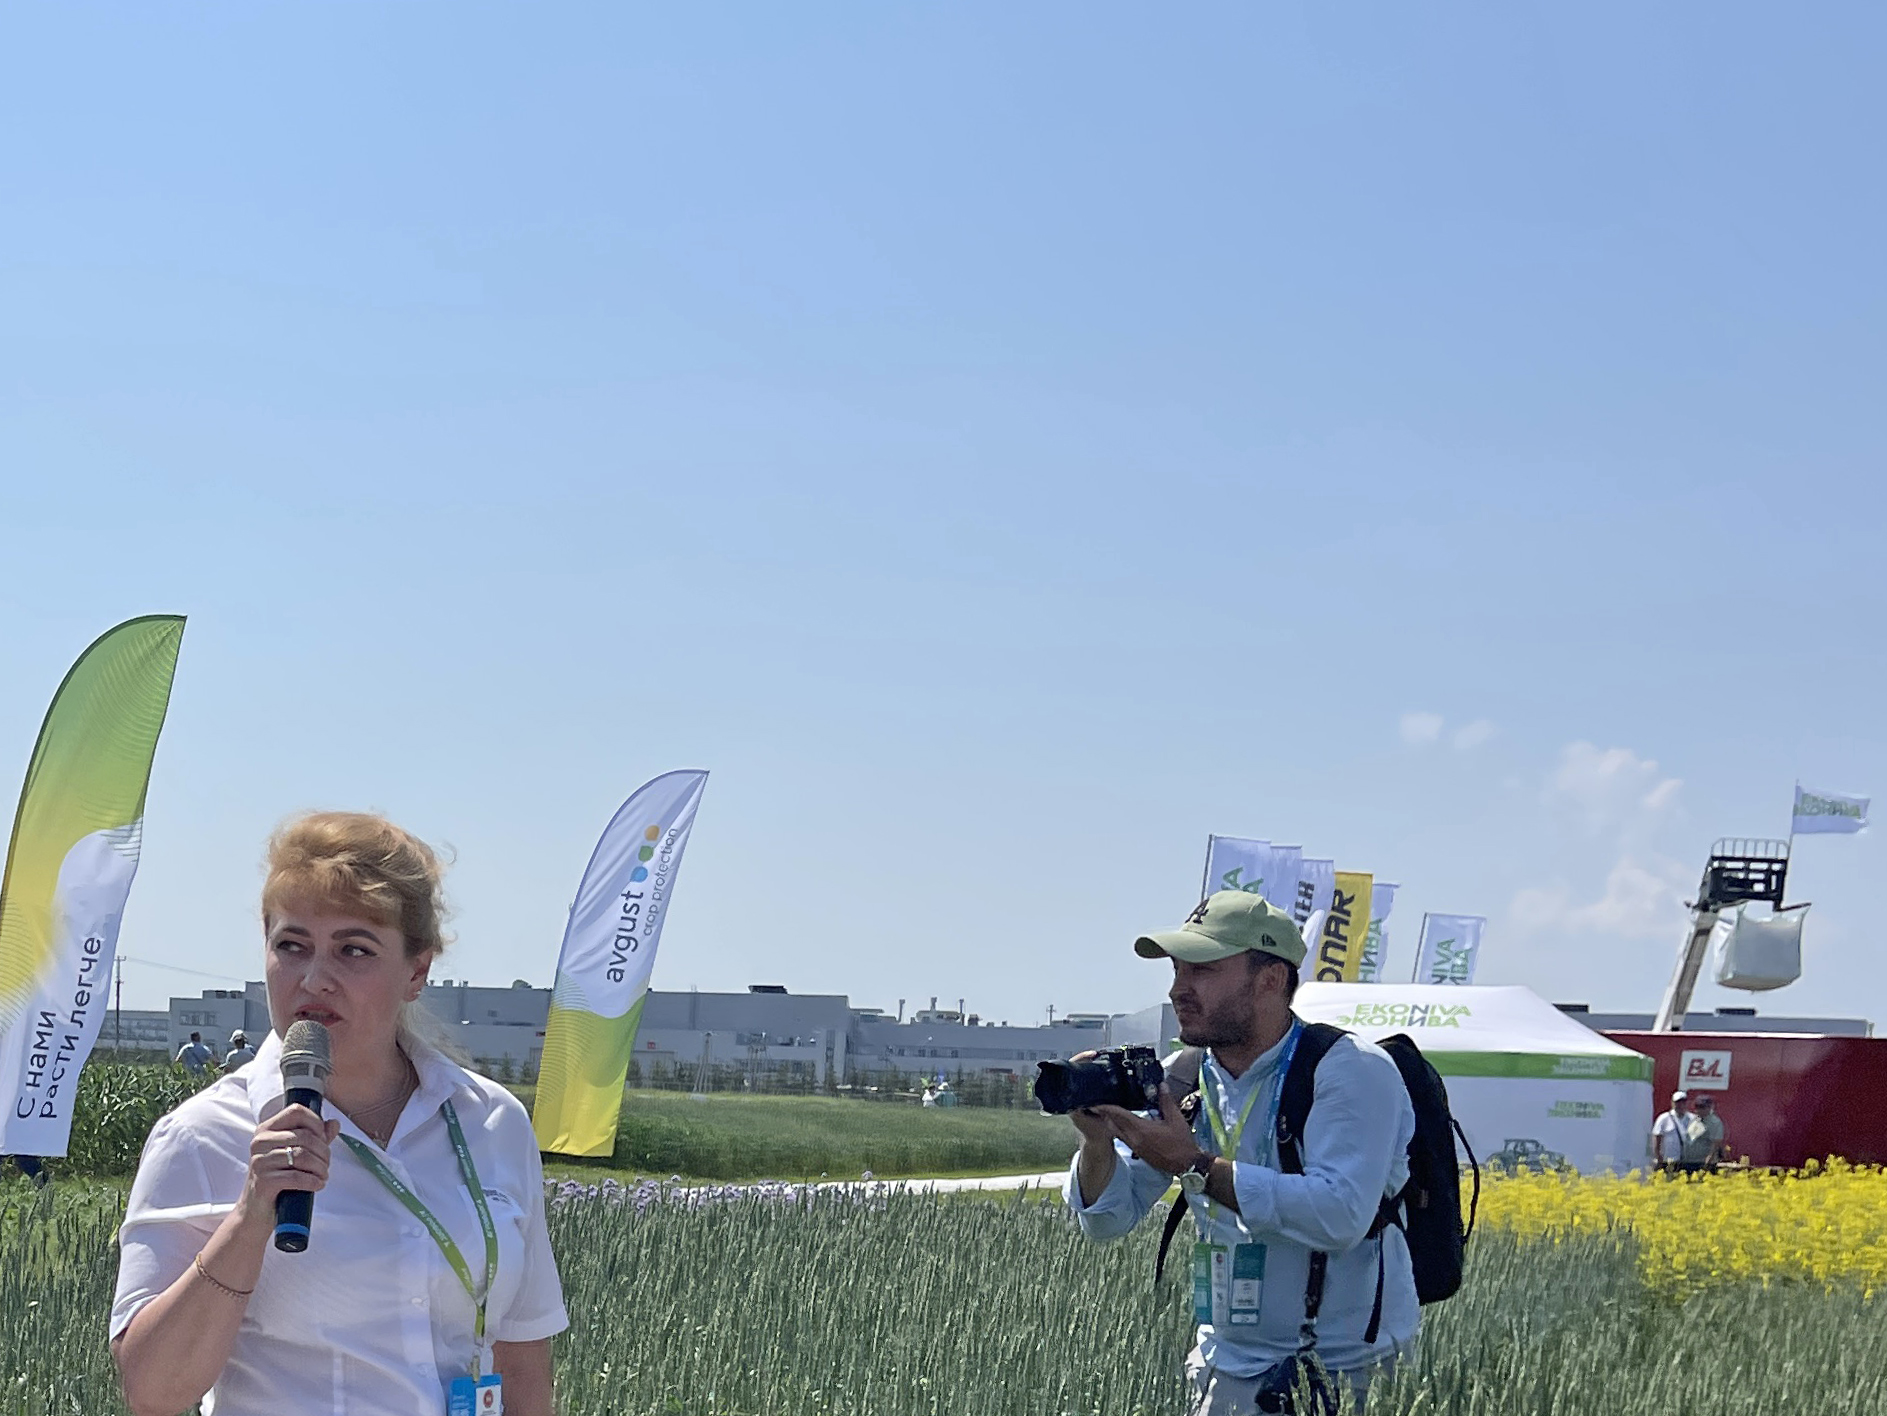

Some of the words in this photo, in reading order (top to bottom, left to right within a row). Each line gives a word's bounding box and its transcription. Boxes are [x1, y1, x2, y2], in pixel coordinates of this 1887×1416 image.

[644, 904, 659, 936] crop
[652, 828, 678, 901] protection
[607, 890, 643, 983] avgust
[39, 1035, 79, 1119] расти
[70, 937, 101, 1029] легче
[1335, 1014, 1460, 1028] ЭКОНИВА
[1355, 1003, 1472, 1016] EKONIVA
[17, 1097, 35, 1119] С
[26, 1011, 56, 1088] нами
